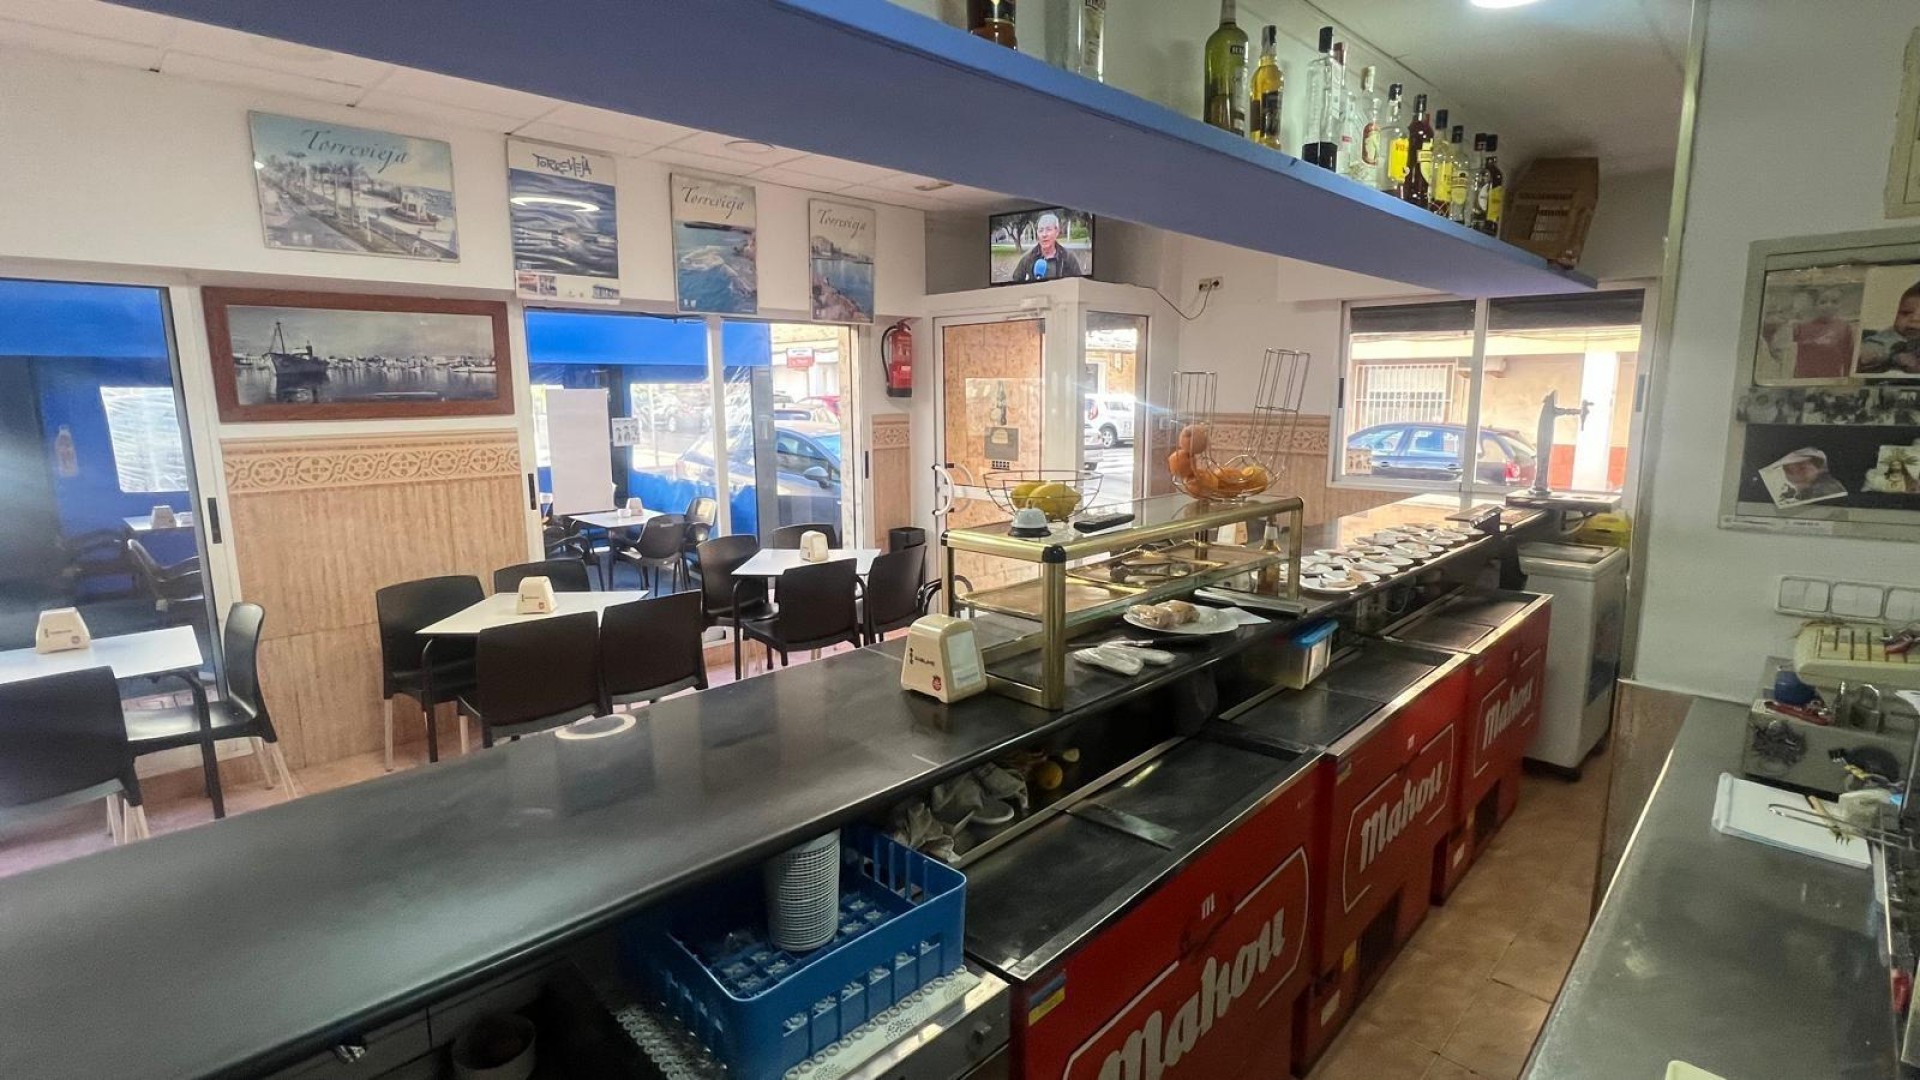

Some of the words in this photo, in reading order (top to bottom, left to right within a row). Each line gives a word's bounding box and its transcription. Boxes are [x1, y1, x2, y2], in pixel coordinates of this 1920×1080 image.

[301, 127, 411, 174] Torrevieja
[681, 185, 745, 219] Torrevieja
[816, 209, 867, 239] Torrevieja
[1482, 676, 1534, 751] Mahou
[1360, 761, 1443, 873] Mahou
[1096, 908, 1286, 1080] Mahou
